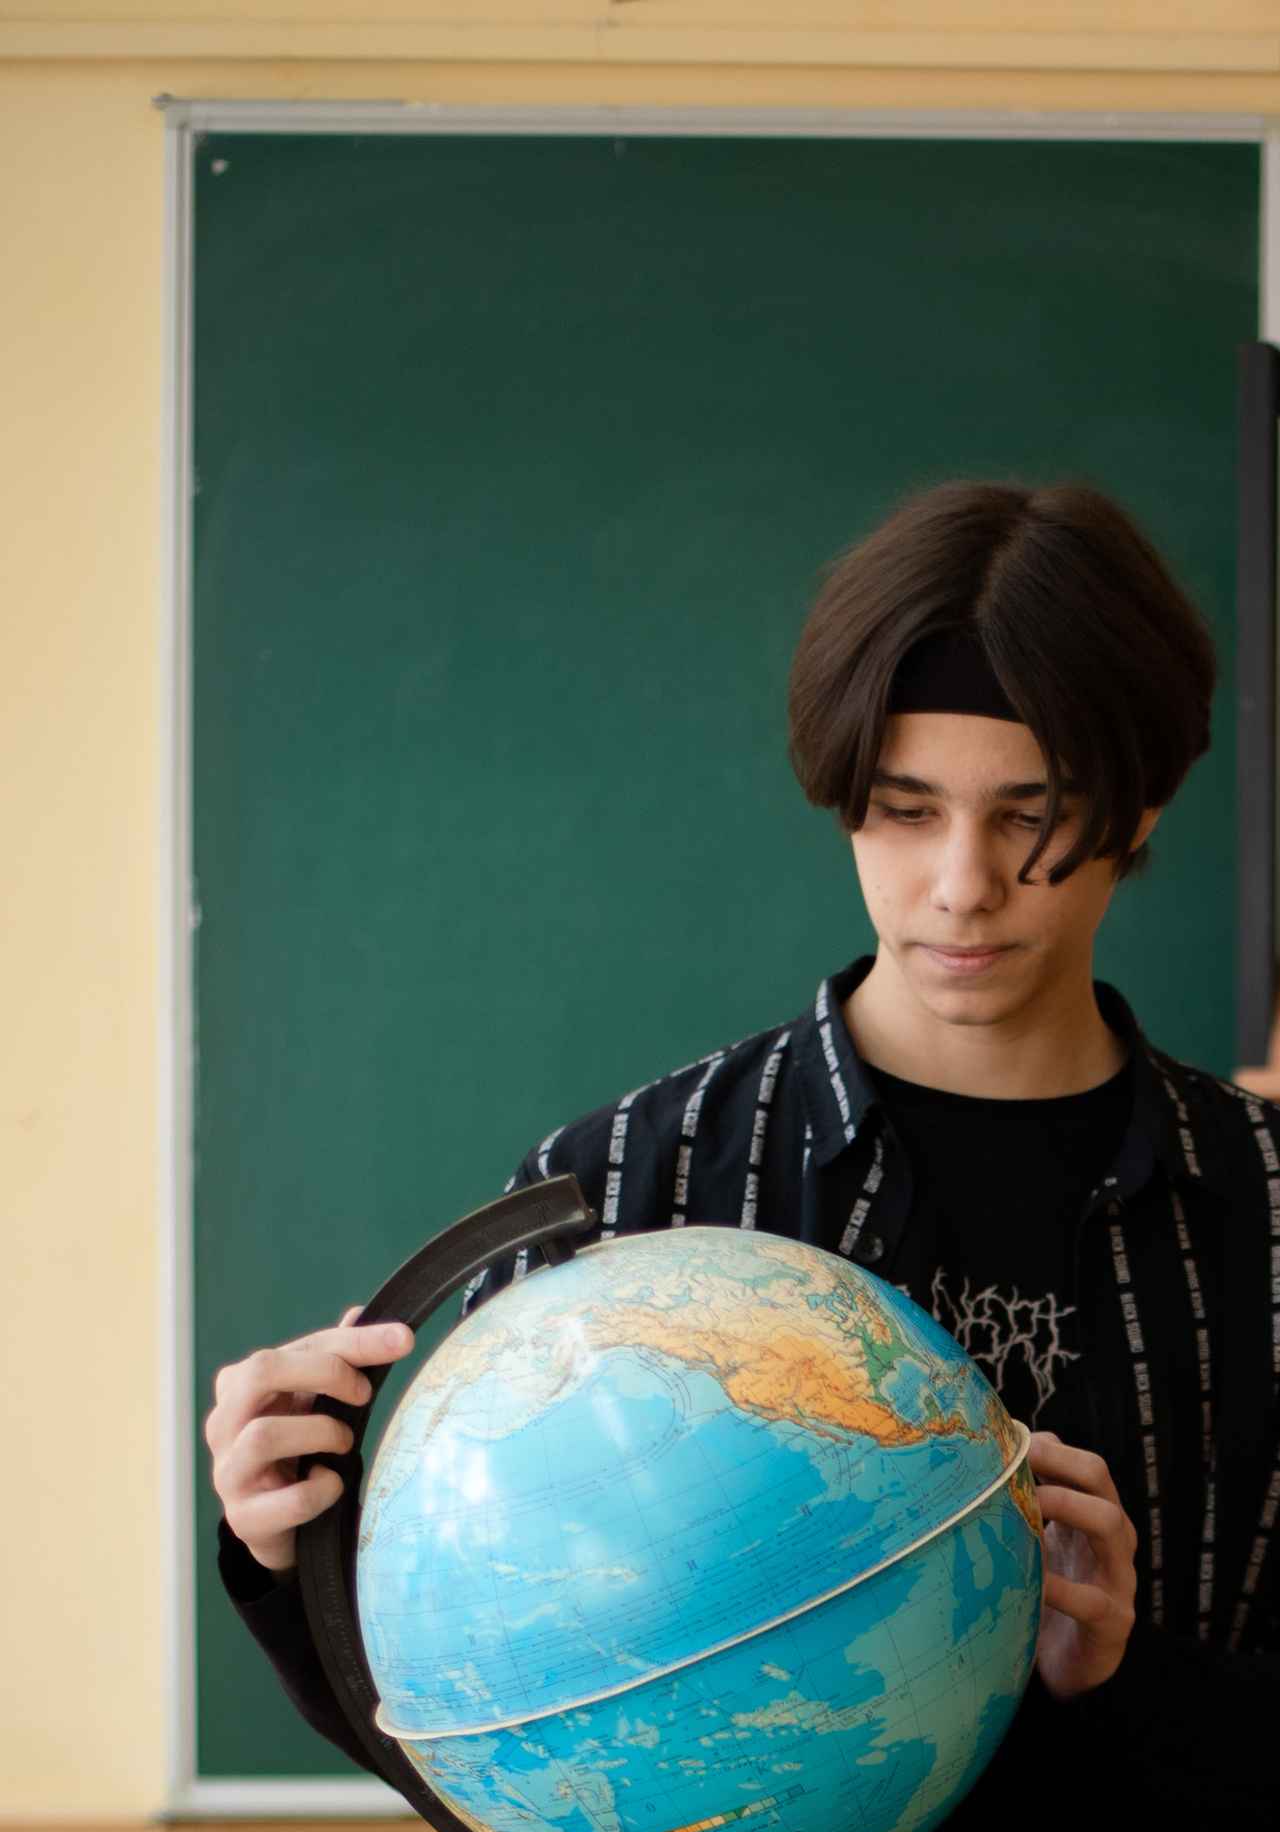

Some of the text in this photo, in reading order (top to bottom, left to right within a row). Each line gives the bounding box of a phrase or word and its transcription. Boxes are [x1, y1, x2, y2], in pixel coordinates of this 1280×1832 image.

[839, 1198, 870, 1254] BLACK SQUAD
[1113, 1253, 1130, 1283] SQUAD
[1183, 1259, 1204, 1318] BLACK SQUAD
[1120, 1293, 1143, 1352] BLACK SQUAD
[1133, 1362, 1149, 1391] BLACK
